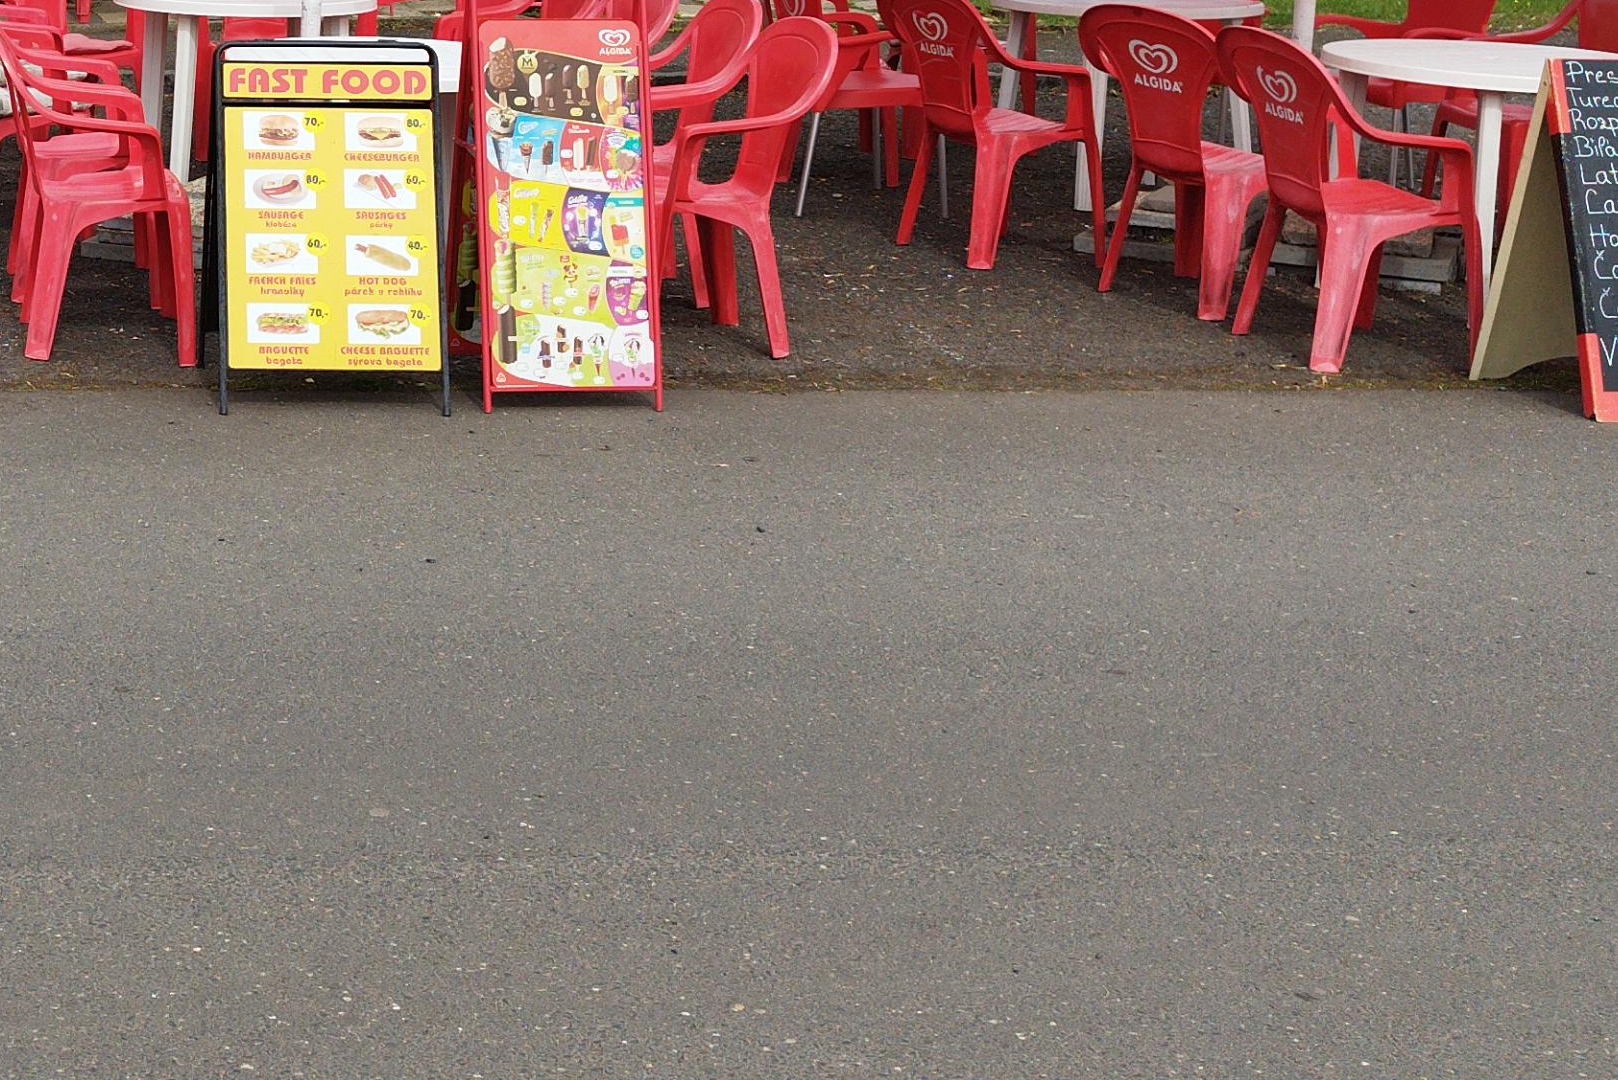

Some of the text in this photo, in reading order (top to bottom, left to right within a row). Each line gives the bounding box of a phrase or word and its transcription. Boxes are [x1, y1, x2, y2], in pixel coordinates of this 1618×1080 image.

[599, 48, 631, 56] ALGIDA
[920, 42, 954, 58] ALGIDA
[522, 57, 533, 67] M
[229, 68, 427, 95] FAST FOOD
[1134, 73, 1182, 93] ALGIDA
[1264, 102, 1304, 124] ALGIDA
[304, 117, 324, 127] 70,-
[248, 151, 312, 161] HAMBURGER
[344, 153, 420, 163] CHEESEBURGER
[258, 210, 304, 220] SAUSAGE
[355, 211, 406, 220] SAUSAGES
[249, 276, 316, 285] FRENCH FRIES
[359, 277, 407, 286] HOT DOG
[260, 287, 305, 297] hranolky
[258, 346, 309, 355] BAGUETTE
[340, 347, 430, 356] CHEESE BAGUETTE
[265, 357, 303, 367] bageta
[386, 358, 423, 367] bageta
